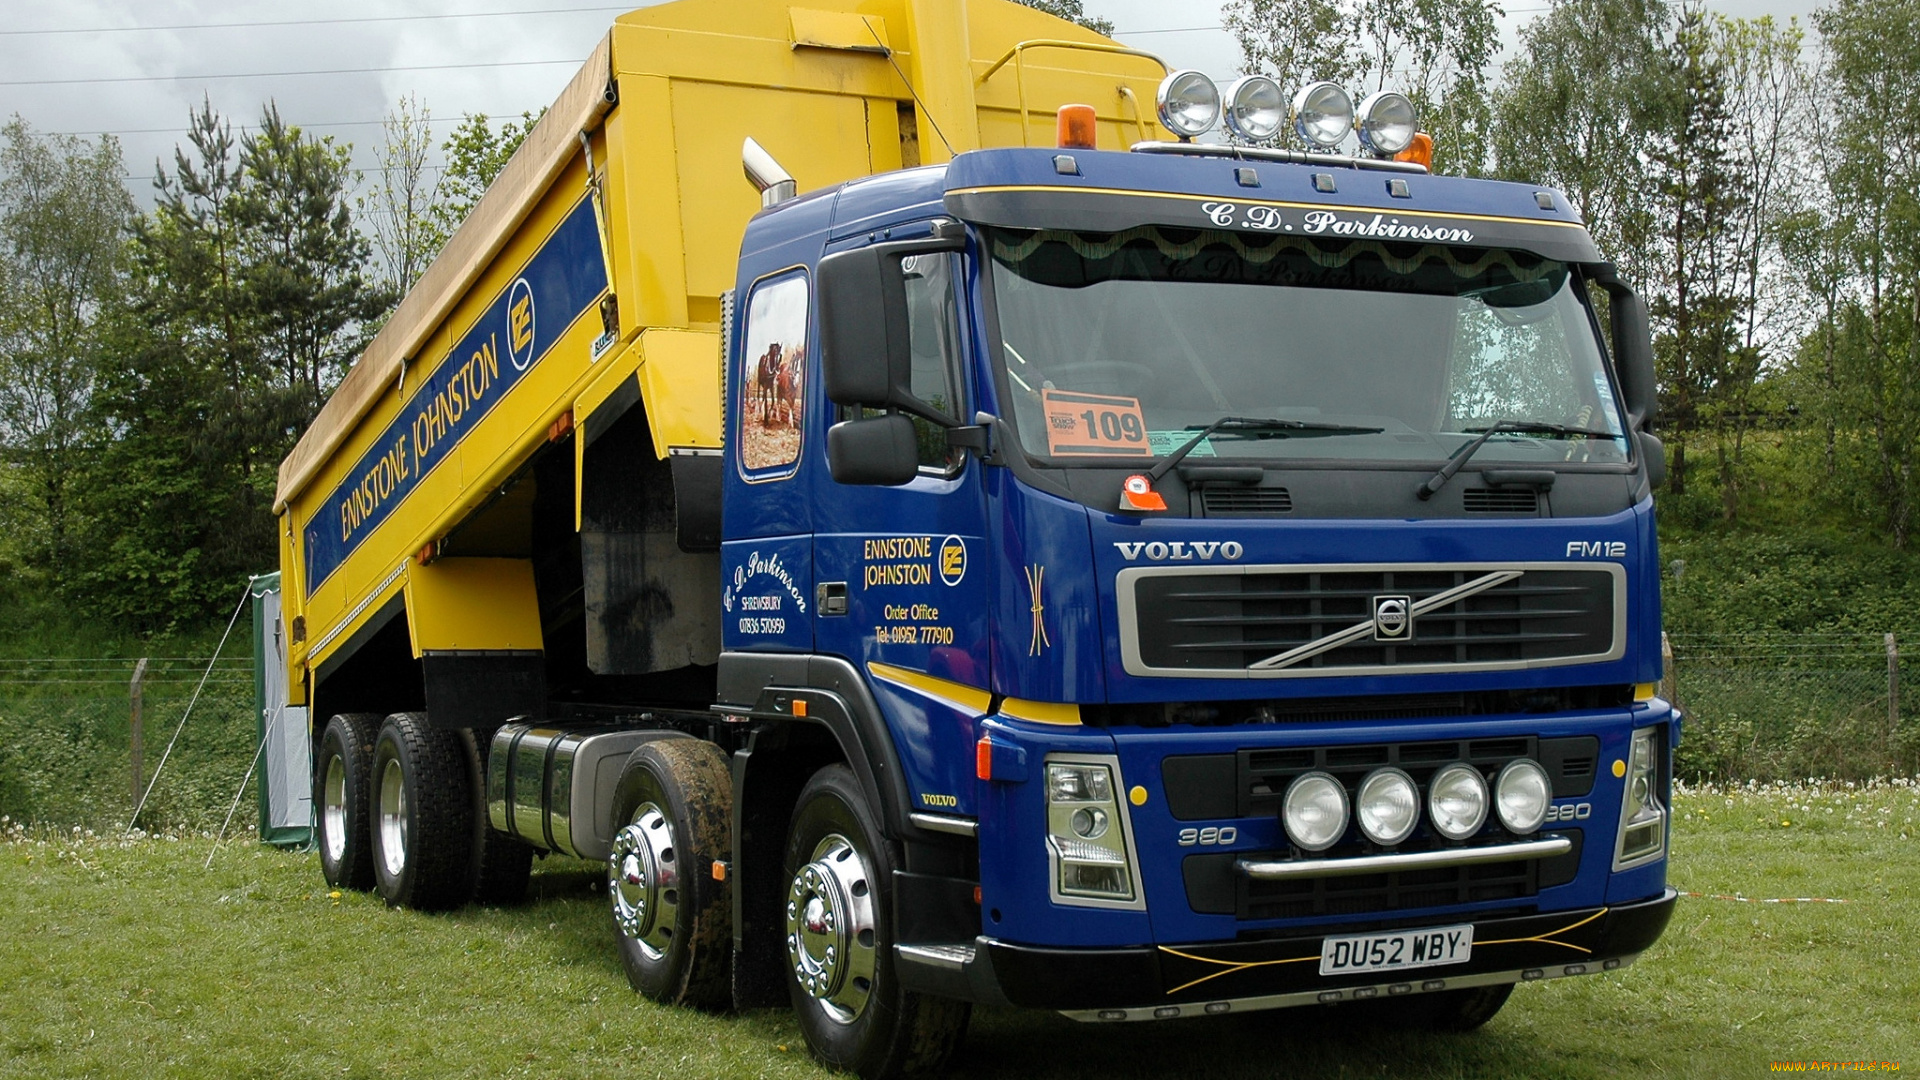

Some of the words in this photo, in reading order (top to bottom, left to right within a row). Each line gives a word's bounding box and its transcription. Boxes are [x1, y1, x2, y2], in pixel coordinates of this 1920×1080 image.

[1303, 210, 1474, 243] Parkinson
[1080, 409, 1143, 442] 109
[340, 433, 409, 543] ENNSTONE
[412, 333, 499, 479] JOHNSTON
[864, 537, 932, 560] ENNSTONE
[1113, 541, 1244, 561] VOLVO
[1565, 541, 1627, 558] FM12
[747, 551, 806, 613] Parkinson
[863, 564, 931, 591] JOHNSTON
[741, 596, 782, 611] SHREWSBURY
[884, 604, 909, 620] Order
[911, 603, 939, 620] Office
[739, 617, 759, 635] 07836
[760, 617, 785, 635] 570959
[892, 626, 917, 644] 01952
[920, 626, 954, 645] 777910
[921, 793, 957, 807] VOLVO
[1178, 826, 1238, 846] 380
[1332, 937, 1405, 969] DU52
[1411, 931, 1462, 962] WBY
